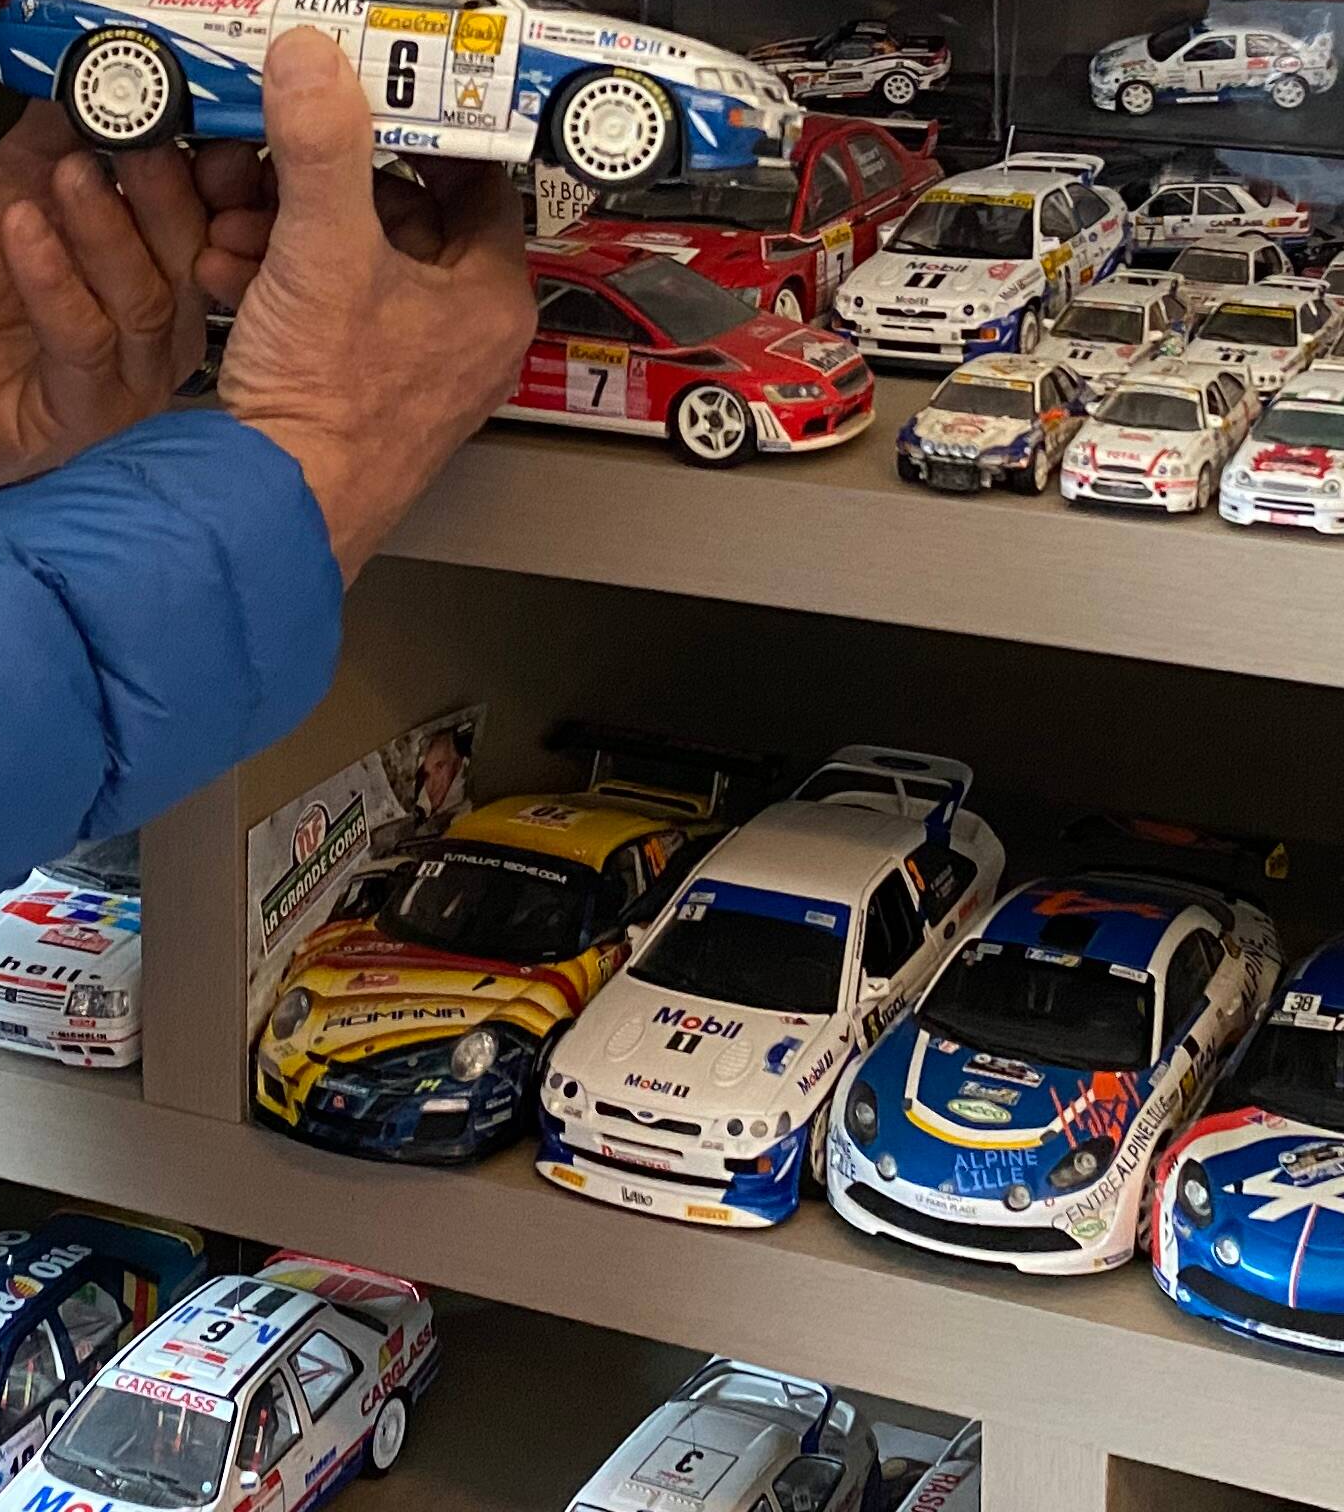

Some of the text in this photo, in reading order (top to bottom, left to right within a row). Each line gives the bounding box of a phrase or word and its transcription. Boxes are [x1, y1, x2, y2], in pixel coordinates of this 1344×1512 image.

[88, 28, 161, 52] MICHELIN
[385, 39, 419, 110] 6
[443, 110, 497, 127] MEDICI
[548, 200, 566, 219] LE
[836, 252, 846, 280] 7
[905, 261, 969, 274] Mobil
[587, 367, 610, 408] 7
[264, 814, 366, 936] LA GRANDE CORSA
[1291, 994, 1312, 1012] 38
[322, 1008, 466, 1032] ROMANIA
[652, 1006, 746, 1041] Mobil
[624, 1073, 672, 1095] Mobil
[955, 1147, 1039, 1171] ALPINE
[956, 1167, 1026, 1193] LILLE
[28, 1243, 93, 1279] Oils
[360, 1326, 434, 1416] CARGLASS
[113, 1374, 218, 1414] CARGLASS
